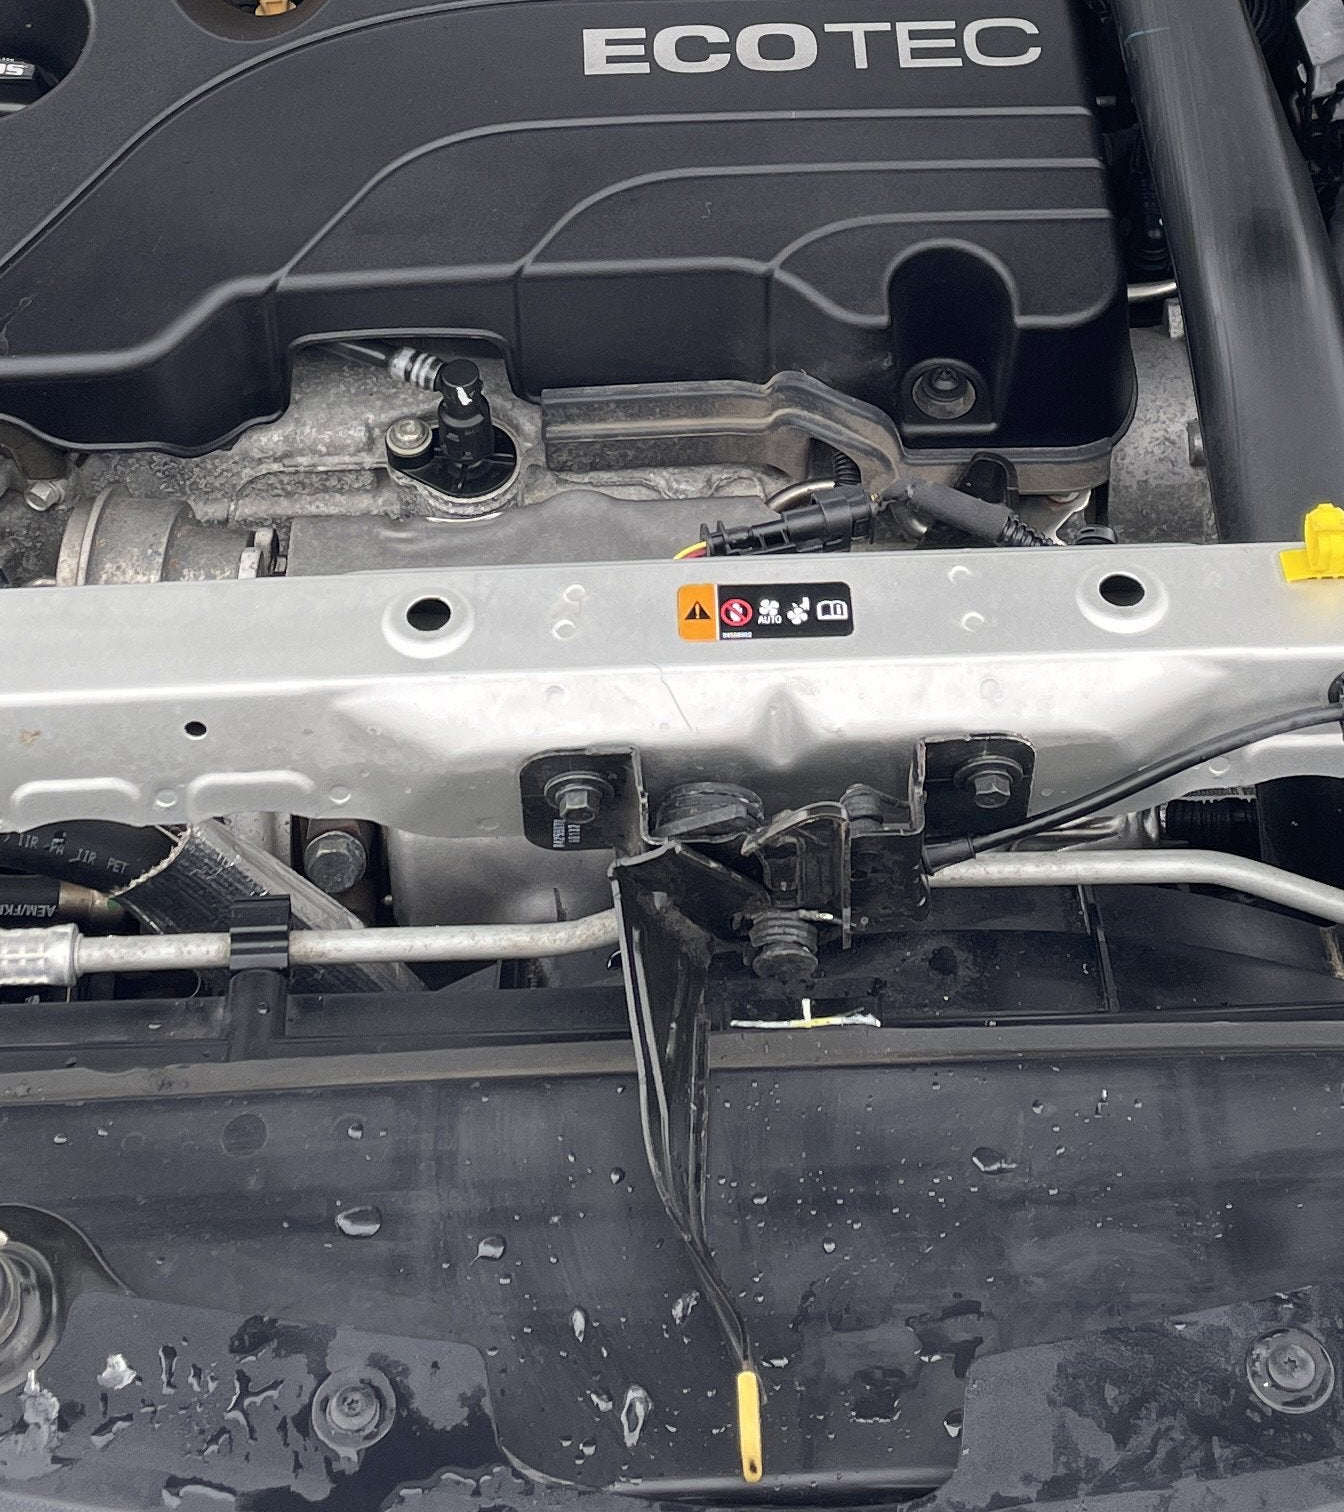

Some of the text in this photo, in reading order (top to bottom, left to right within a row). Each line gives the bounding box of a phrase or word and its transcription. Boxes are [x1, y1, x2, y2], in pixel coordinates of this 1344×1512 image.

[583, 17, 1043, 76] ECOTEC
[757, 614, 783, 625] AUTO
[106, 857, 128, 875] PET
